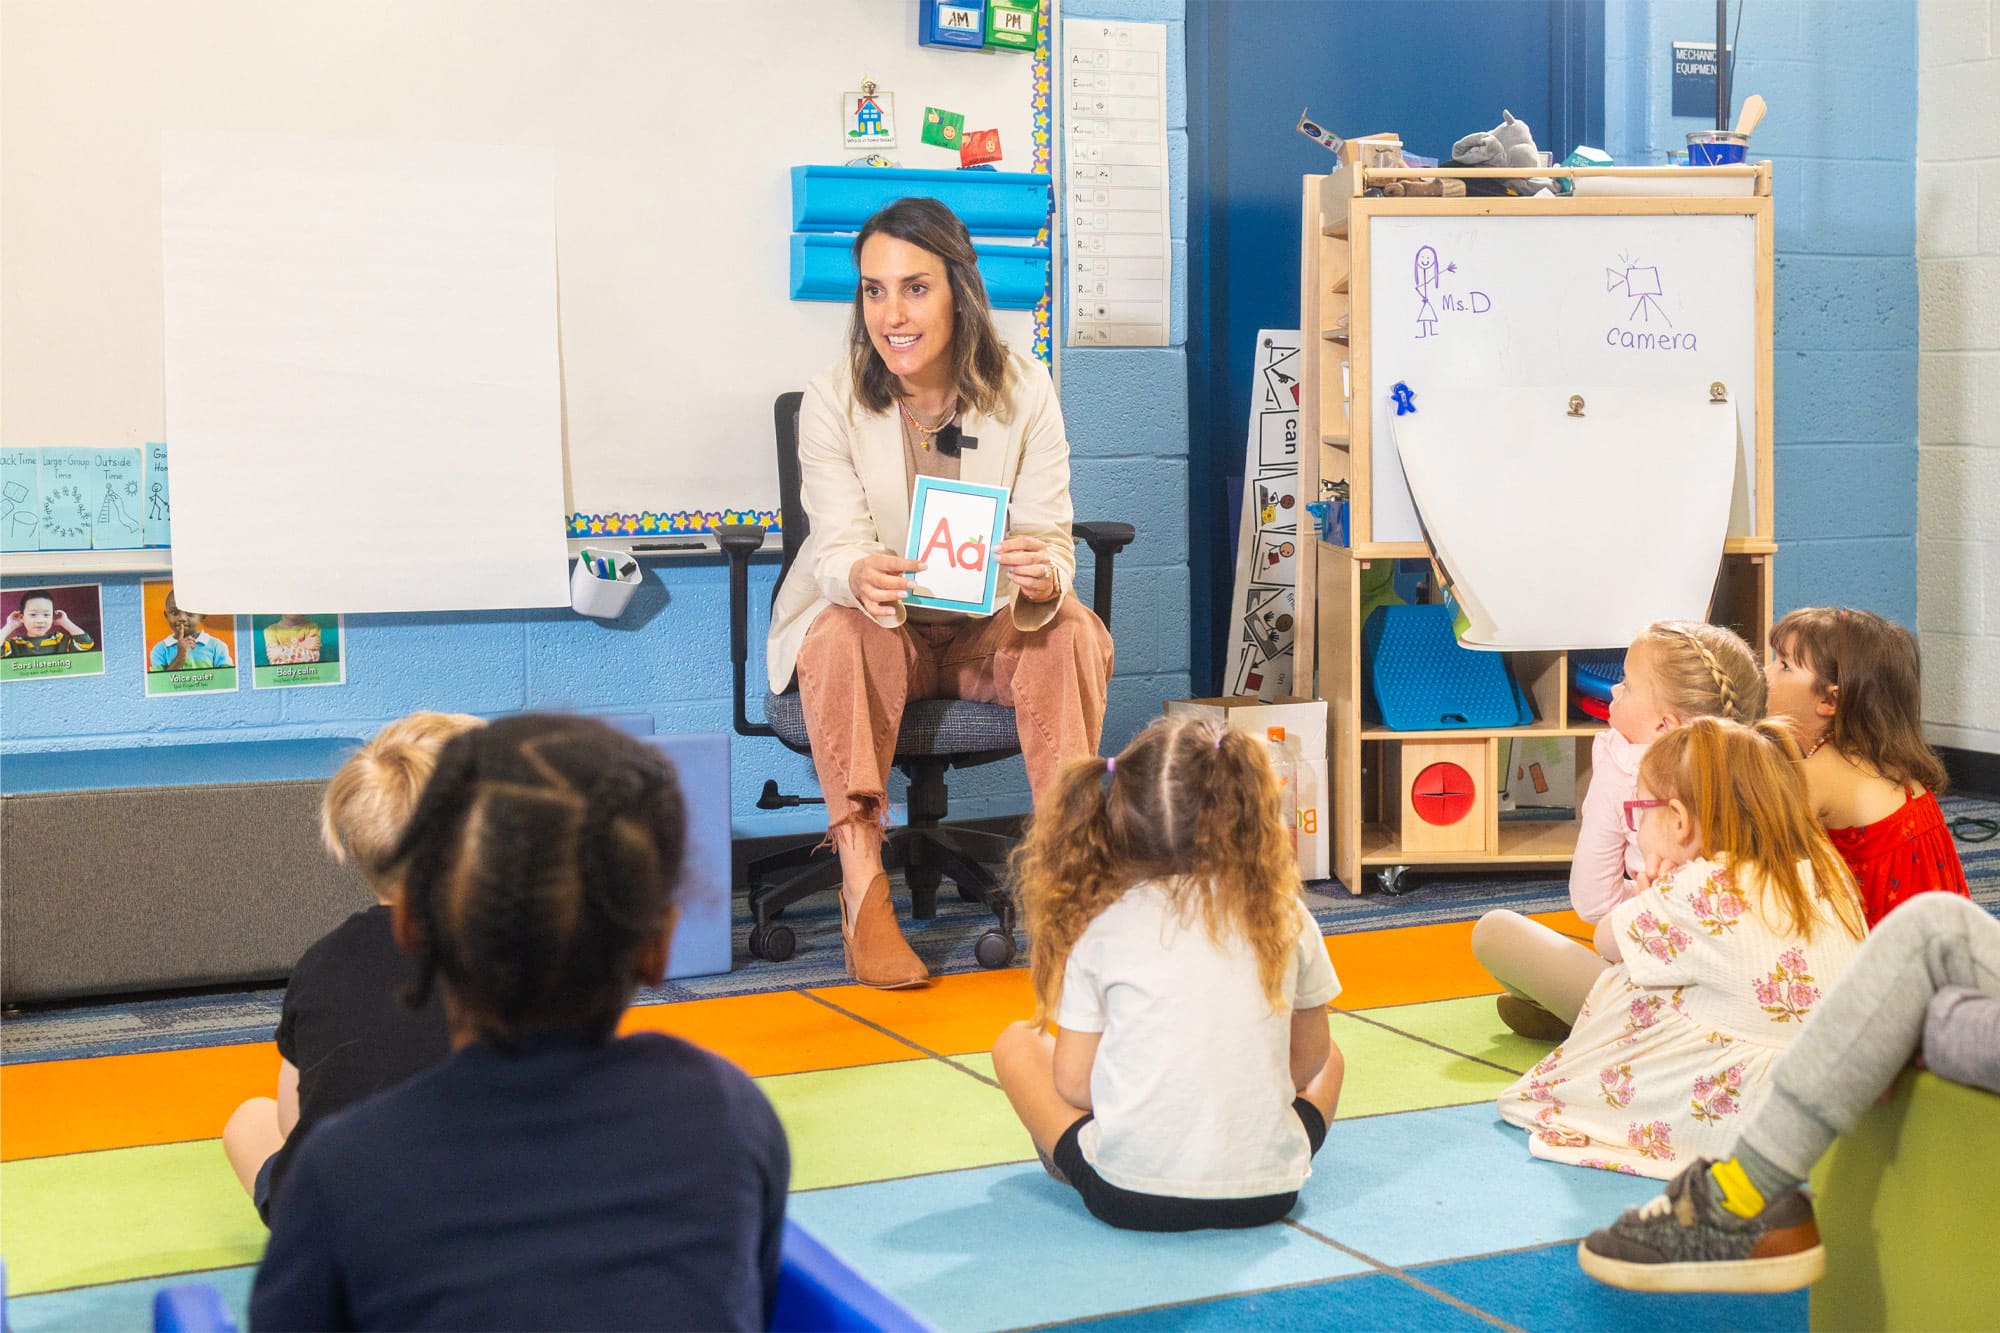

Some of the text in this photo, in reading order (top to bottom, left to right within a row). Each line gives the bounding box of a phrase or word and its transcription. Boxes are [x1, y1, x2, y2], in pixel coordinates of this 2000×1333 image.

[948, 11, 969, 27] AM
[1006, 13, 1021, 29] PM
[1676, 49, 1717, 61] MECHANIC
[1676, 63, 1717, 75] EQUIPMEN
[1284, 418, 1297, 455] can
[0, 454, 16, 466] ack
[43, 455, 90, 469] Large-Group
[95, 454, 131, 467] Outside
[54, 468, 72, 480] Time
[104, 470, 123, 480] Time
[920, 517, 986, 572] Aa
[12, 659, 71, 670] Ears listening
[169, 673, 214, 684] Voice quiet
[276, 667, 297, 680] Body
[298, 666, 317, 675] calm
